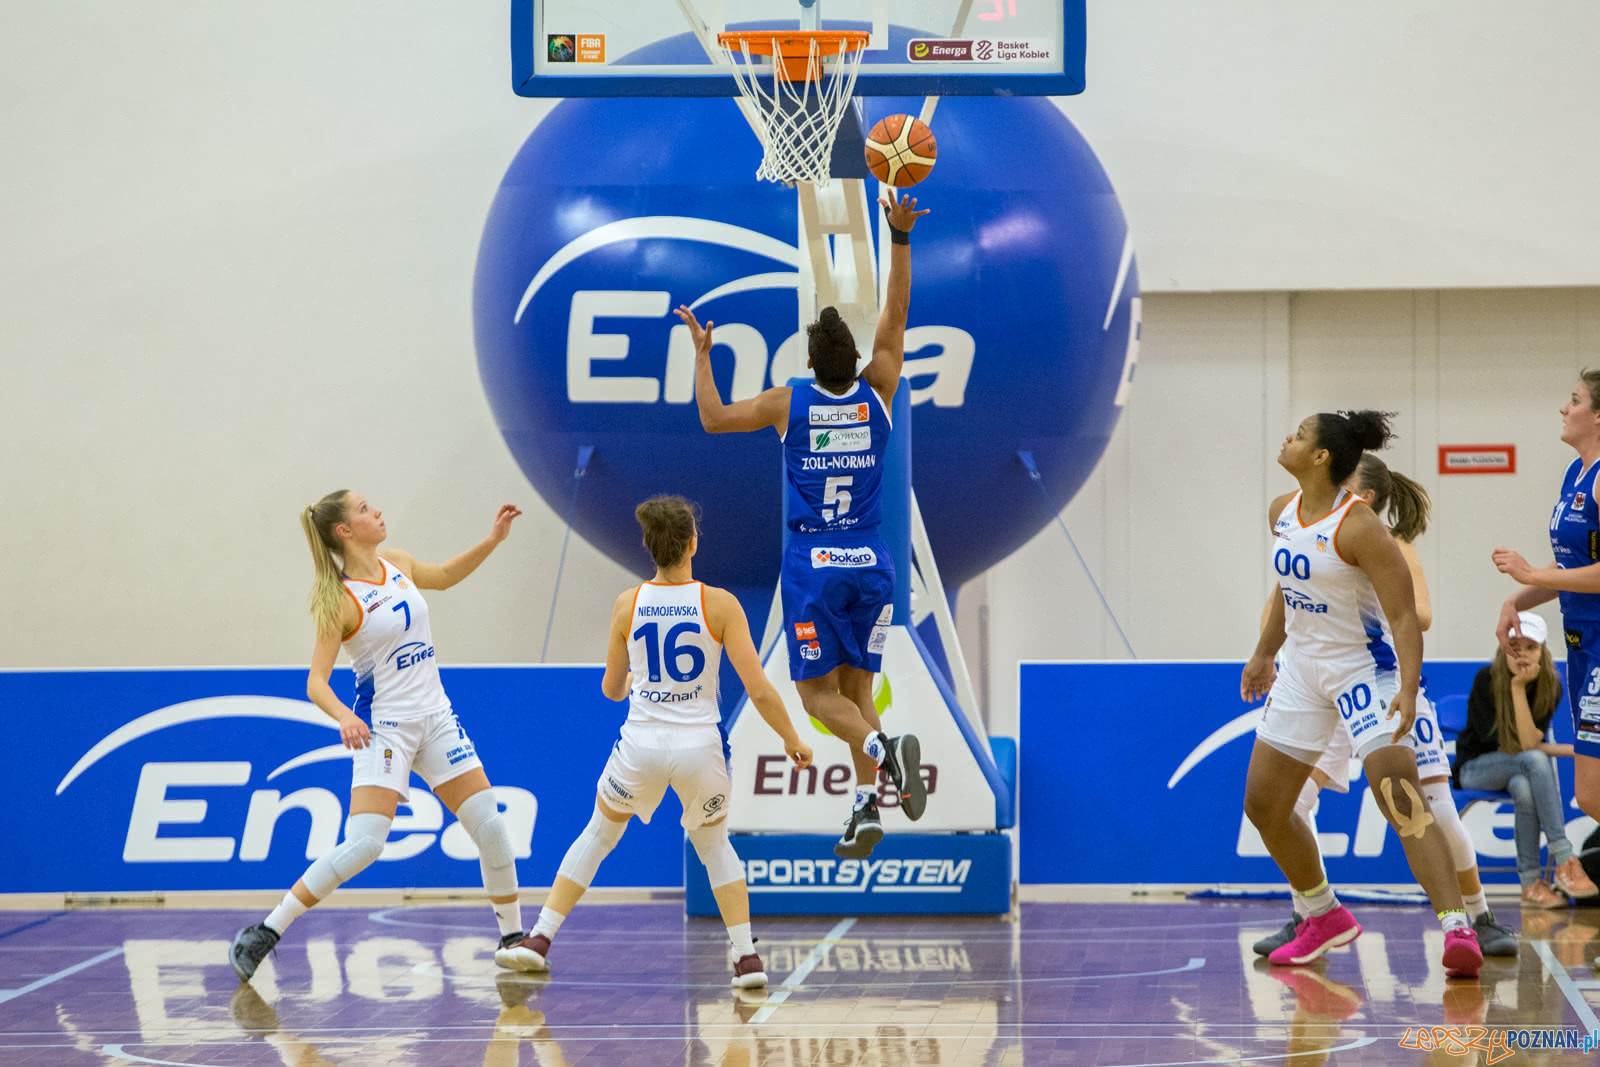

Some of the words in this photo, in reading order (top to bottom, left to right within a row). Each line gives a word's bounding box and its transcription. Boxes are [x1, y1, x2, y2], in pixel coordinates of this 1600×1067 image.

[932, 45, 967, 56] Energa
[997, 41, 1029, 50] Basket
[997, 51, 1017, 60] Liga
[1020, 51, 1049, 59] Kobiet
[566, 290, 977, 407] Ena
[801, 454, 876, 470] ZOLL-NORMAN
[821, 475, 853, 523] 5
[829, 551, 872, 564] bokaro
[1274, 548, 1310, 580] 00
[392, 599, 411, 632] 7
[638, 605, 698, 617] NIEMOJEWSKA
[396, 645, 435, 671] Enea
[633, 621, 706, 683] 16
[1336, 682, 1372, 720] 00
